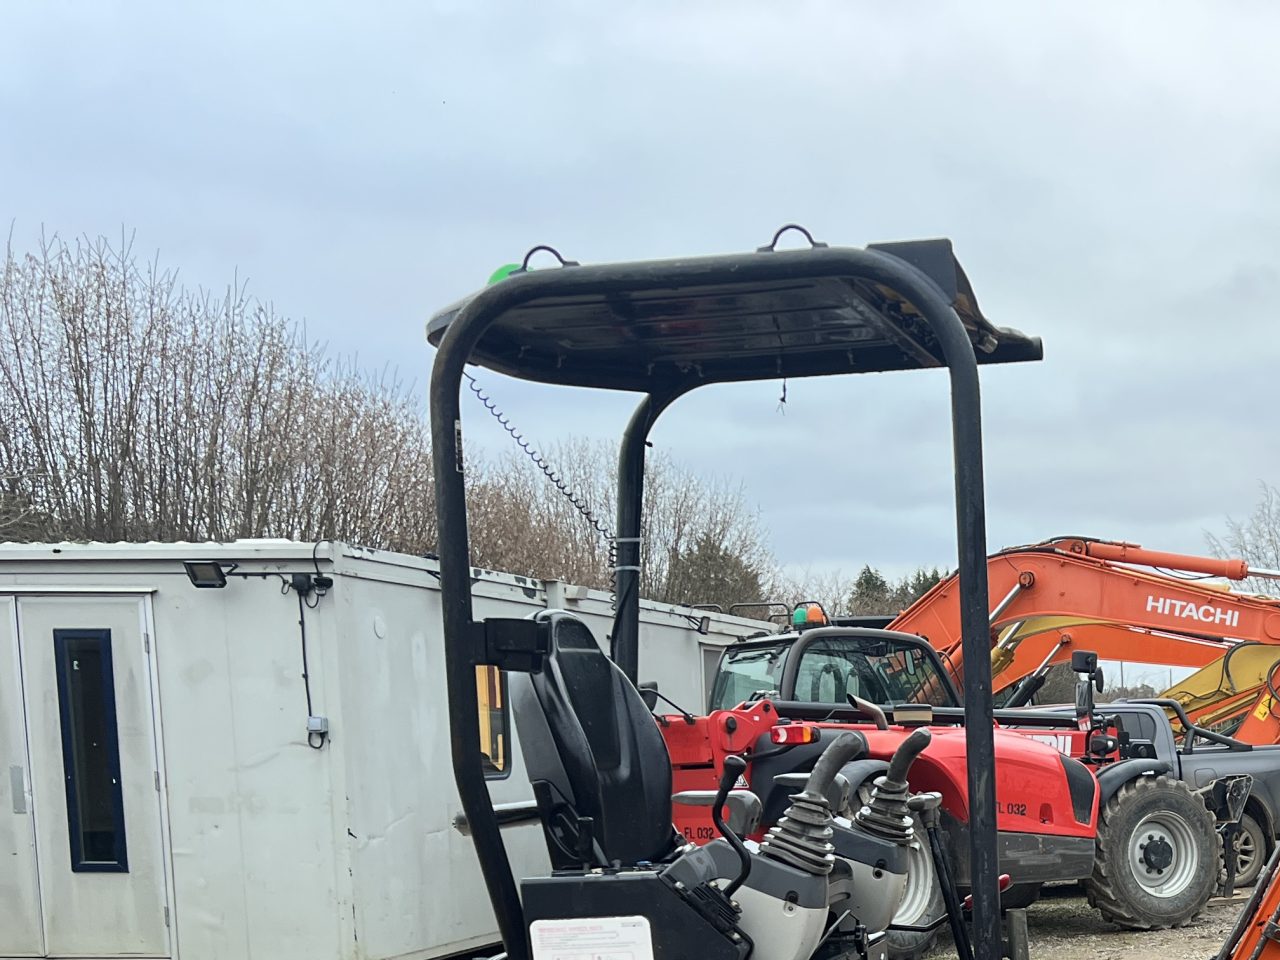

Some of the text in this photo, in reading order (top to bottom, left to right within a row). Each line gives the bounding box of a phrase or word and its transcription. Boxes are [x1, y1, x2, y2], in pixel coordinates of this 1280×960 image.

[1146, 596, 1239, 627] HITACHI
[1007, 803, 1027, 816] 032
[684, 827, 715, 840] FL 032
